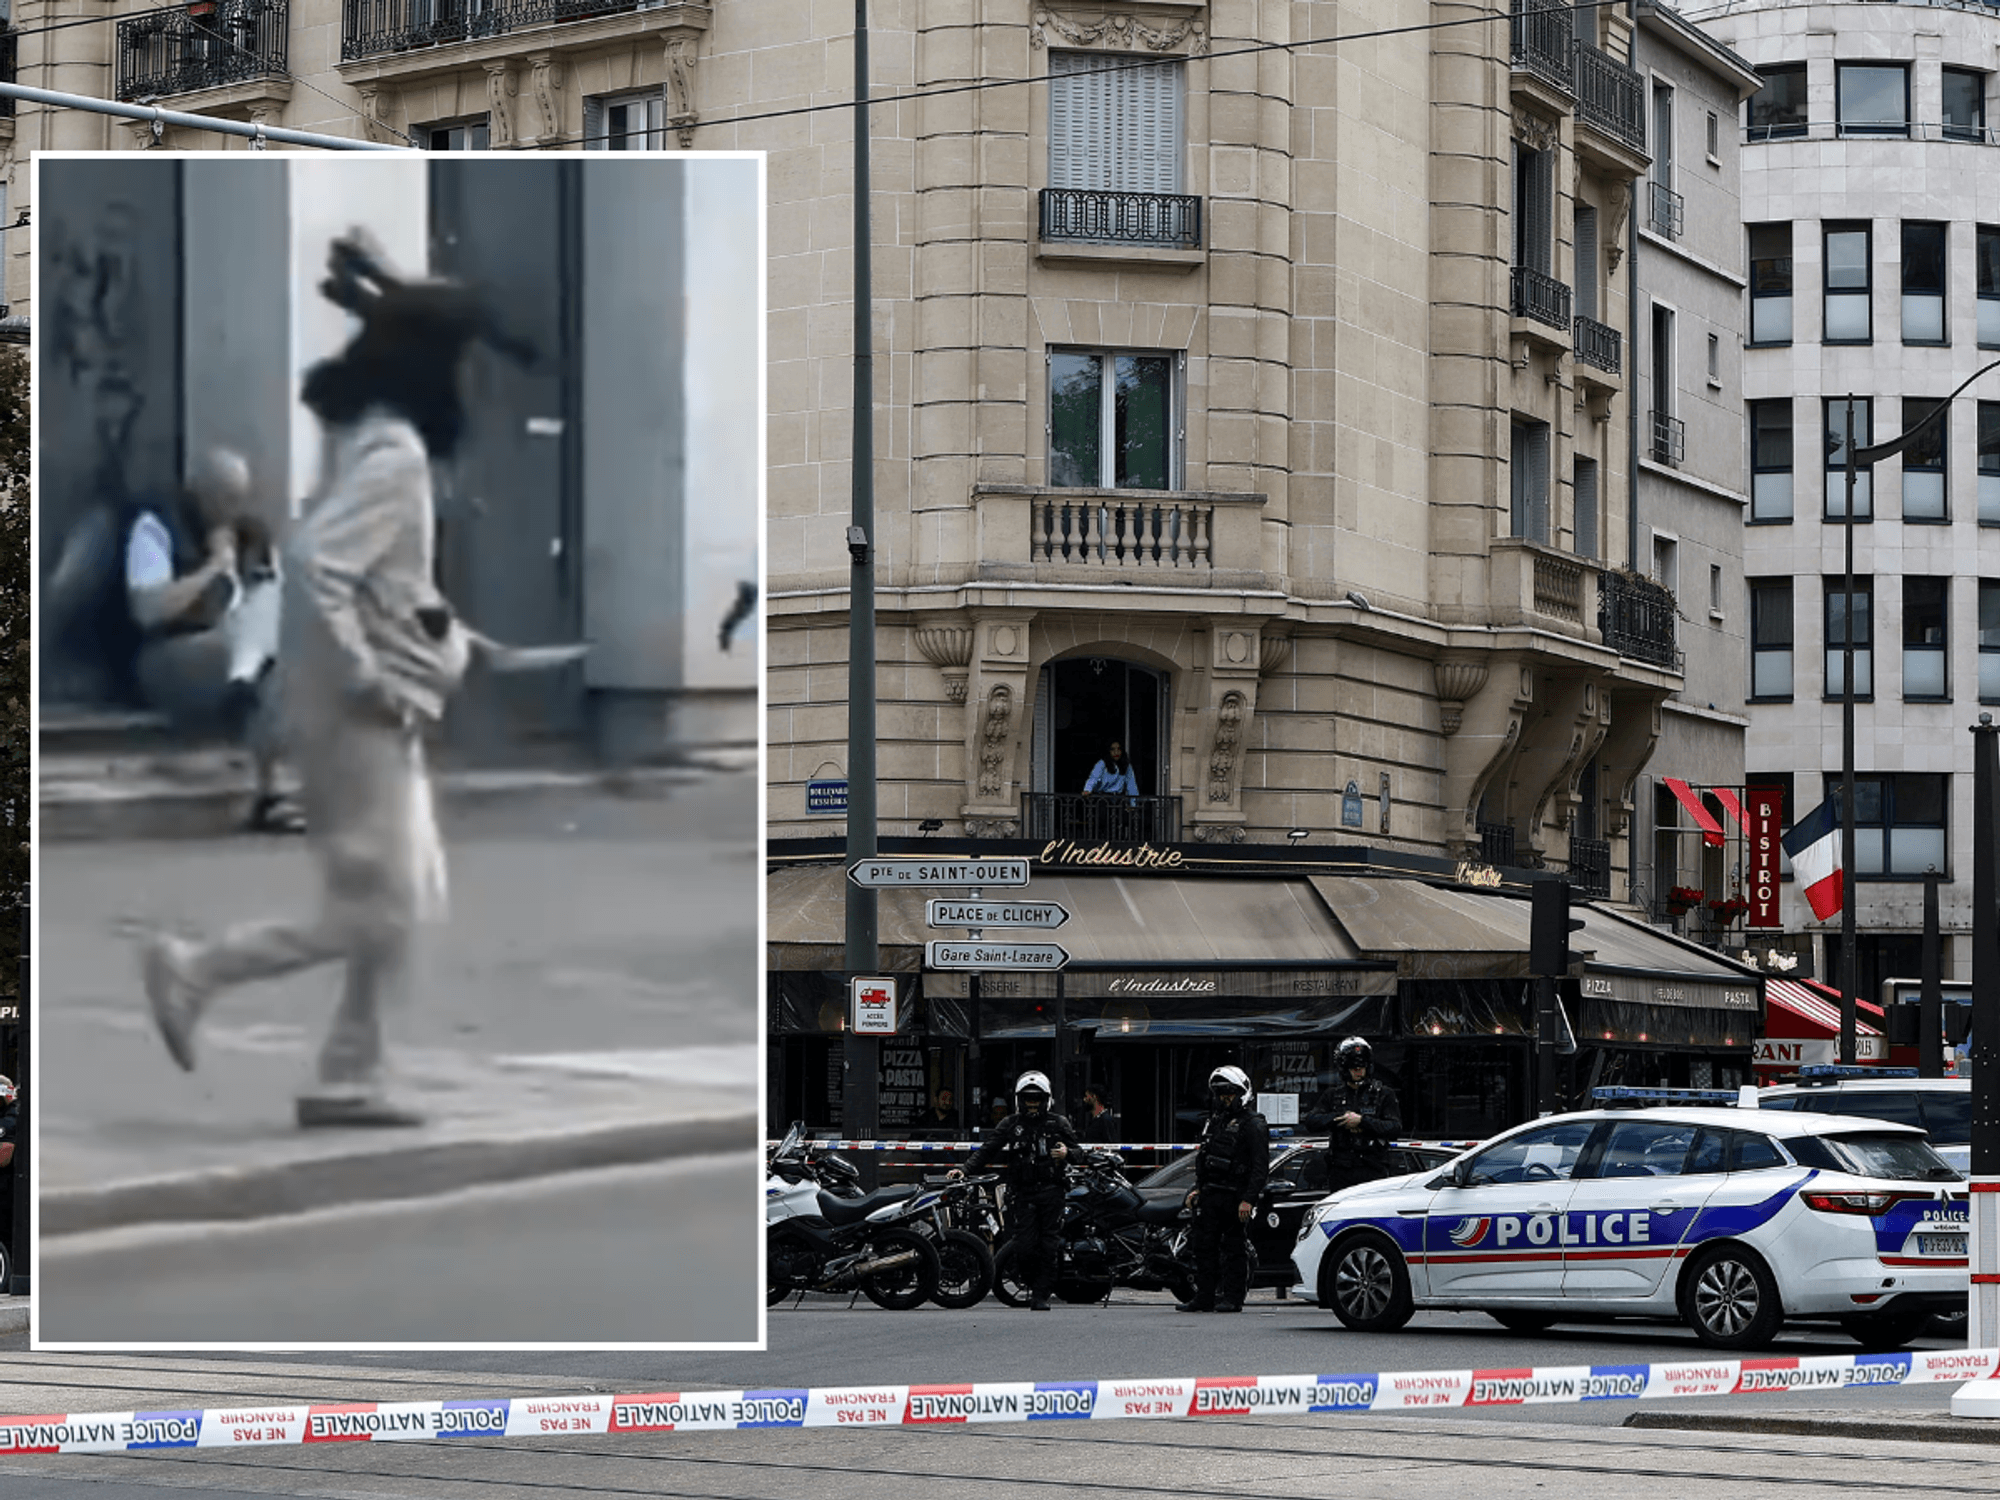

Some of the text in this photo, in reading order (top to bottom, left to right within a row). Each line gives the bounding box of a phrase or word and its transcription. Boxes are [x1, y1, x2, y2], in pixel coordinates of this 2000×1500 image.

[1040, 839, 1183, 867] l'Industrie
[1757, 803, 1772, 917] BISTROT
[898, 872, 912, 880] DE
[919, 866, 1021, 880] SAINT-OUEN
[939, 907, 1053, 922] PLACE DE CLICHY
[941, 949, 1053, 963] Gare Saint-Lazare
[961, 981, 1021, 993] BSSERIE
[1108, 977, 1217, 992] l'Industrie
[1293, 980, 1360, 991] RESTAURANT
[1586, 979, 1612, 993] PIZZA
[1724, 991, 1751, 1004] PASTA
[883, 1049, 923, 1067] PIZZA
[1272, 1054, 1316, 1073] PIZZA
[885, 1068, 925, 1087] PASTA
[1275, 1075, 1319, 1093] PASTA
[1923, 1210, 1966, 1222] POLICE
[1497, 1213, 1650, 1246] POLICE
[1664, 1368, 1730, 1381] FRANCHIR
[1744, 1365, 1905, 1388] POLICE NATIONALE
[1393, 1377, 1461, 1389] FRANCHIR
[1476, 1376, 1643, 1399] POLICE NATIONALE
[1701, 1383, 1719, 1393] NE
[825, 1392, 896, 1405] FRANCHIR
[1114, 1386, 1183, 1398] FRANCHIR
[1199, 1384, 1372, 1407] POLICE NATIONALE
[1404, 1393, 1450, 1405] NE PAS
[526, 1401, 601, 1414] FRANCHIR
[913, 1391, 1091, 1415] POLICE NATIONALE
[1125, 1401, 1173, 1414] NE PAS
[220, 1411, 296, 1424] FRANCHIR
[618, 1401, 801, 1424] POLICE NATIONALE
[837, 1409, 887, 1423] NE PAS
[313, 1410, 504, 1433] POLICE NATIONALE
[540, 1417, 592, 1431] NE PAS
[0, 1420, 197, 1445] POLICE NATIONALE
[233, 1427, 286, 1441] NE PAS
